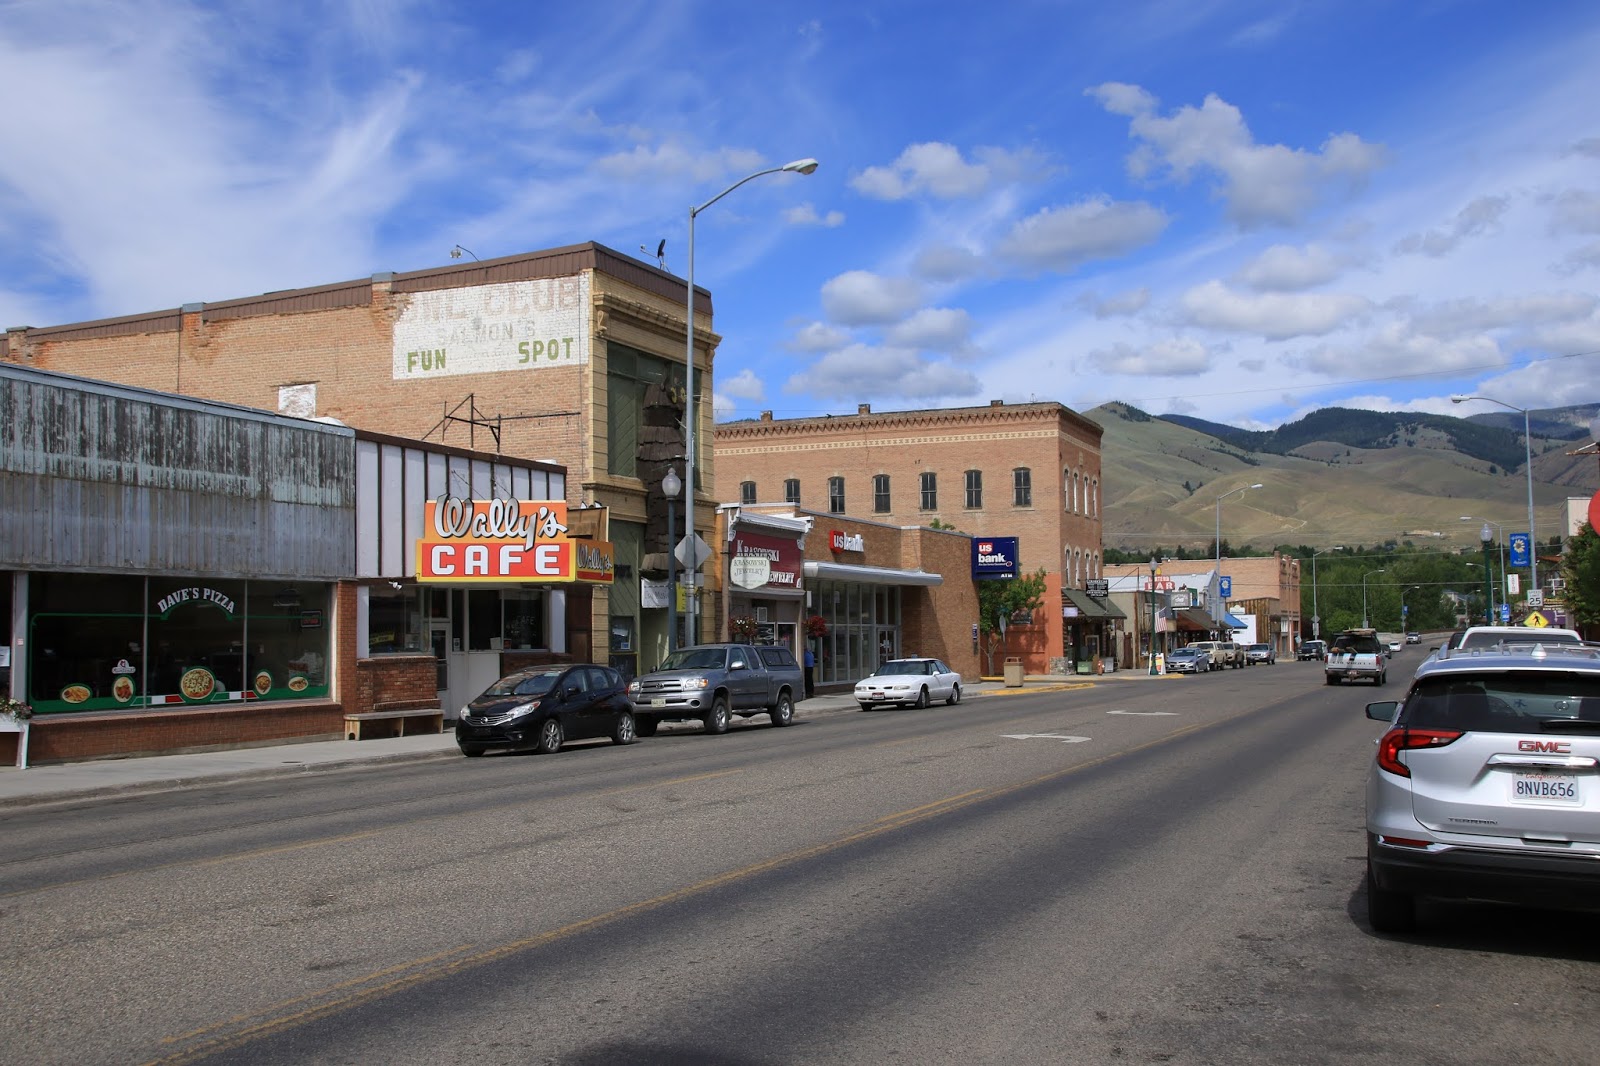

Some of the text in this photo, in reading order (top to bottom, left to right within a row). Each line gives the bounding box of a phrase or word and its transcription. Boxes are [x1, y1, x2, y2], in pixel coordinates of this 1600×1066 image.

[407, 337, 574, 373] FUN SPOT
[434, 493, 567, 551] Wally's
[979, 544, 992, 552] us
[431, 544, 560, 575] CAFE
[577, 544, 613, 577] Wally's
[978, 553, 1006, 563] bank
[734, 567, 764, 576] JEWELRY
[769, 571, 794, 583] EWELRY
[157, 587, 235, 614] DAVE'S PIZZA
[1529, 597, 1541, 606] 25
[1518, 740, 1571, 753] GMC
[1517, 781, 1574, 797] 8NVB656
